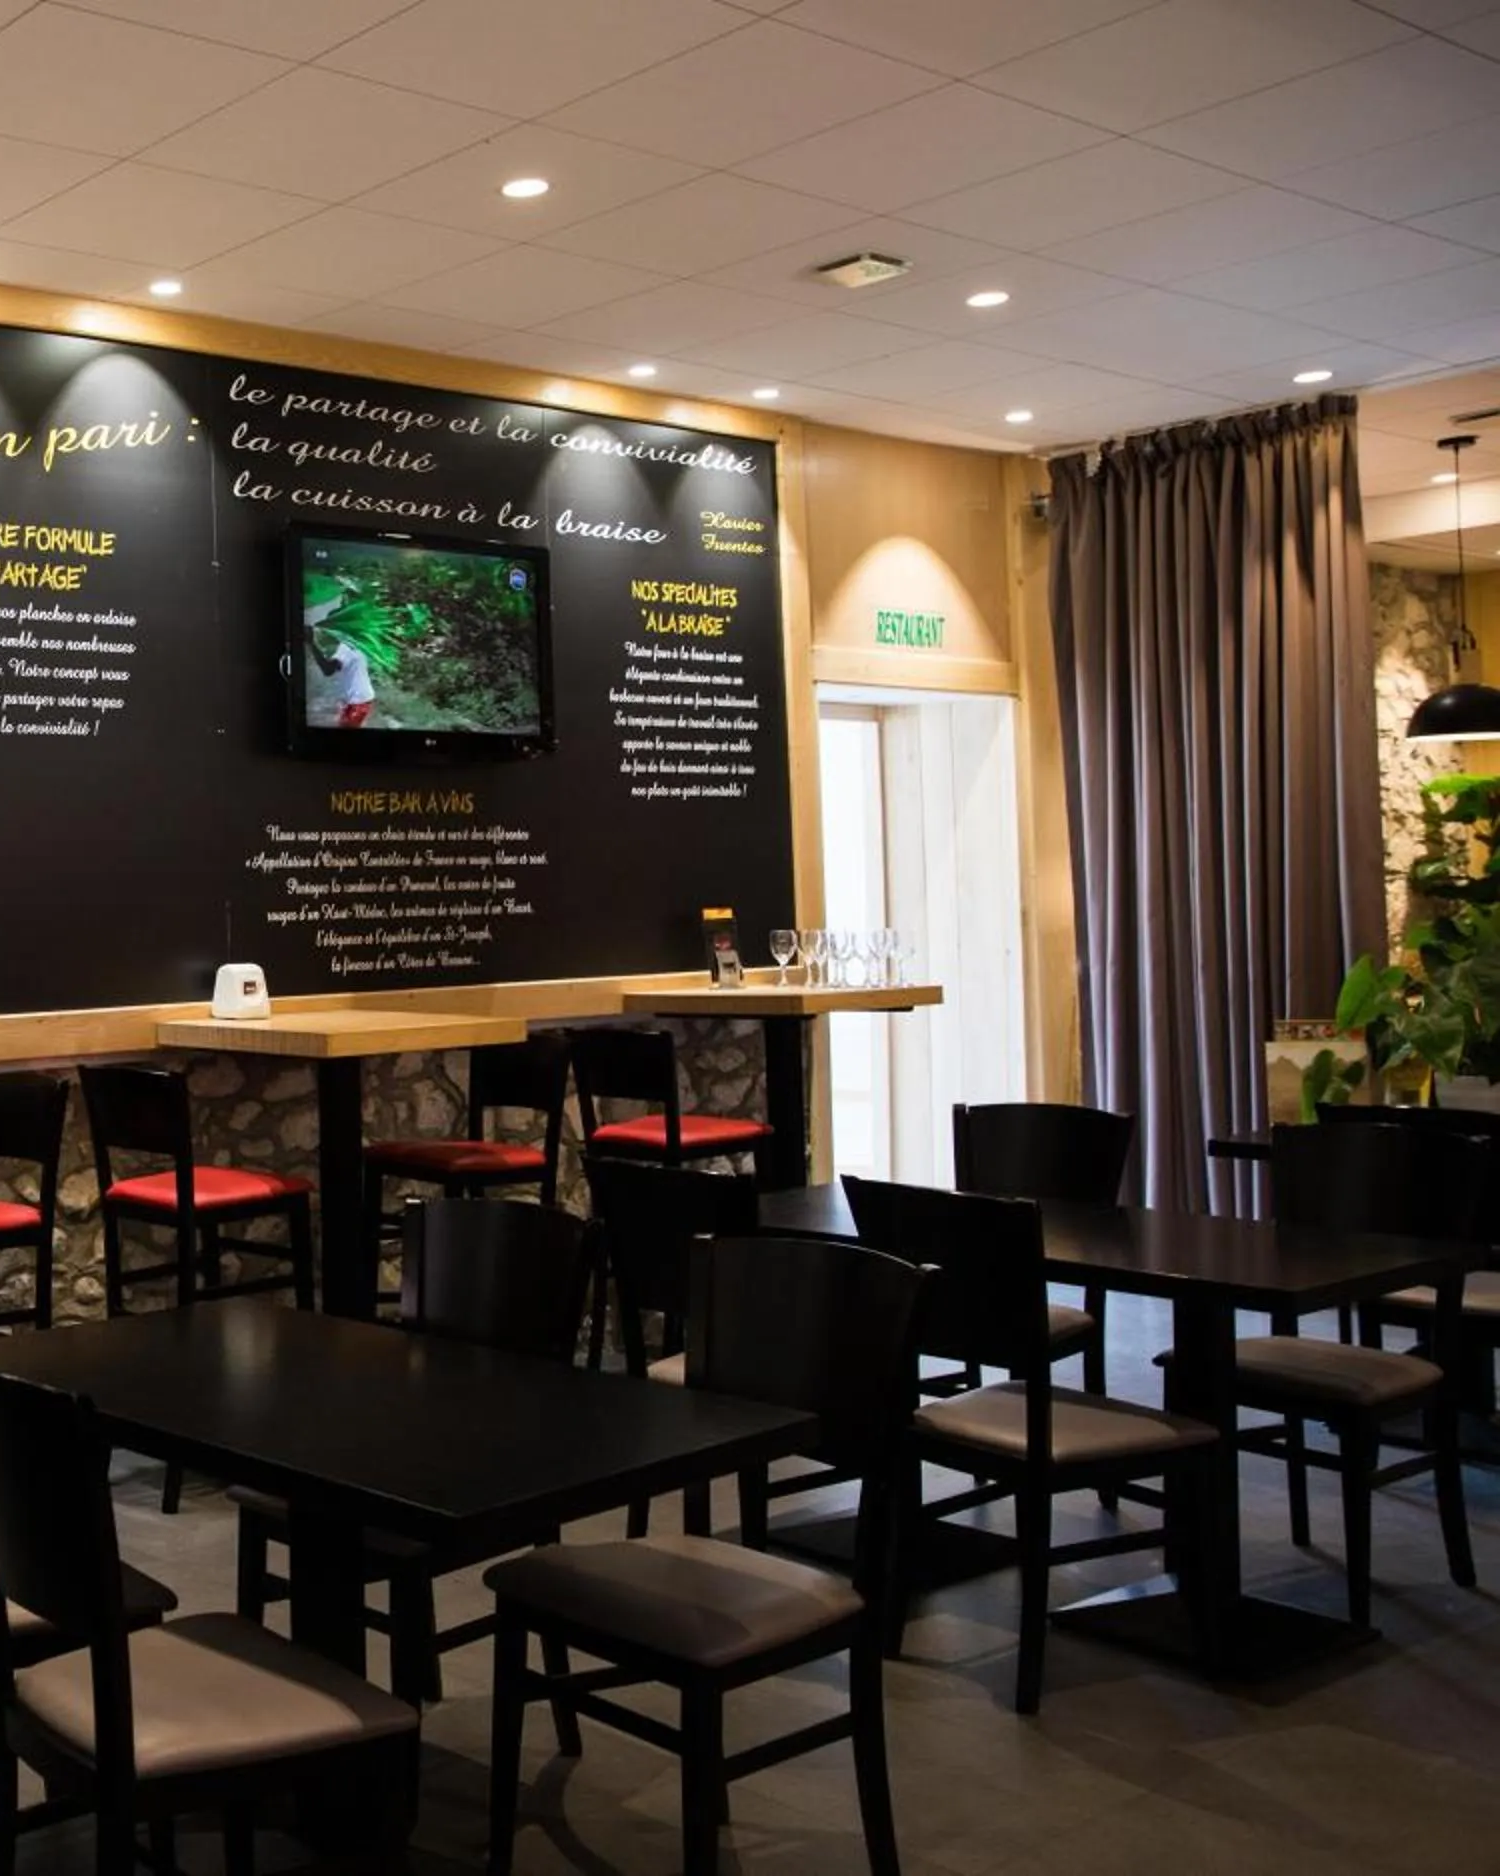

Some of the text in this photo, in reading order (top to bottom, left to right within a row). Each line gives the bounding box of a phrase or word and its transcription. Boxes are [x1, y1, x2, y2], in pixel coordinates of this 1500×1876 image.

[230, 374, 758, 476] le partage et la convivialité
[44, 412, 170, 472] pari
[232, 422, 436, 472] la qualité
[233, 471, 667, 544] la cuisson à la braise
[700, 510, 763, 530] Xavier
[24, 526, 116, 555] FORMULE
[702, 533, 765, 553] Fuentes
[632, 581, 658, 601] NOS
[18, 602, 77, 624] planches
[76, 613, 94, 623] en
[90, 609, 136, 626] ardoise
[876, 611, 945, 648] RESTAURANT
[41, 640, 64, 650] nos
[63, 635, 136, 653] nombreuses
[8, 658, 51, 677] Notre
[53, 667, 98, 683] concept
[102, 671, 130, 680] vous
[332, 790, 474, 814] NOTRE BAR A VINS
